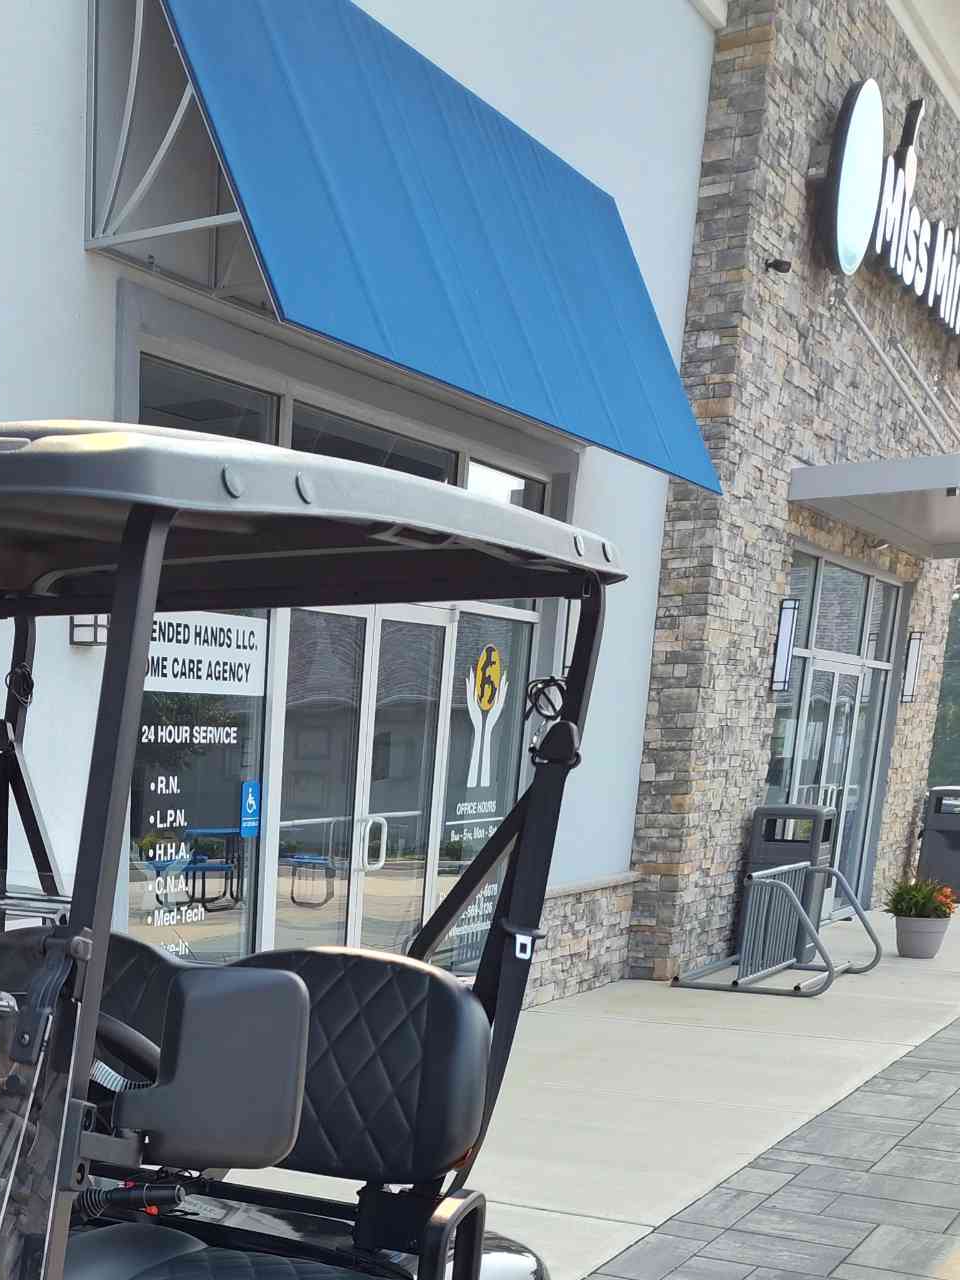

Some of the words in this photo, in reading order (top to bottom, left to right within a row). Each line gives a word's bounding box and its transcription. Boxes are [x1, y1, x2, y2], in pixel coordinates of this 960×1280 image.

[150, 620, 191, 645] ENDED
[194, 624, 233, 649] HANDS
[171, 657, 203, 681] CARE
[205, 659, 251, 684] AGENCY
[141, 724, 155, 744] 24
[157, 724, 191, 744] HOUR
[192, 725, 239, 745] SERVICE
[157, 775, 181, 795] R.N.
[156, 809, 188, 829] L.P.N.
[154, 904, 205, 927] Med-Tech
